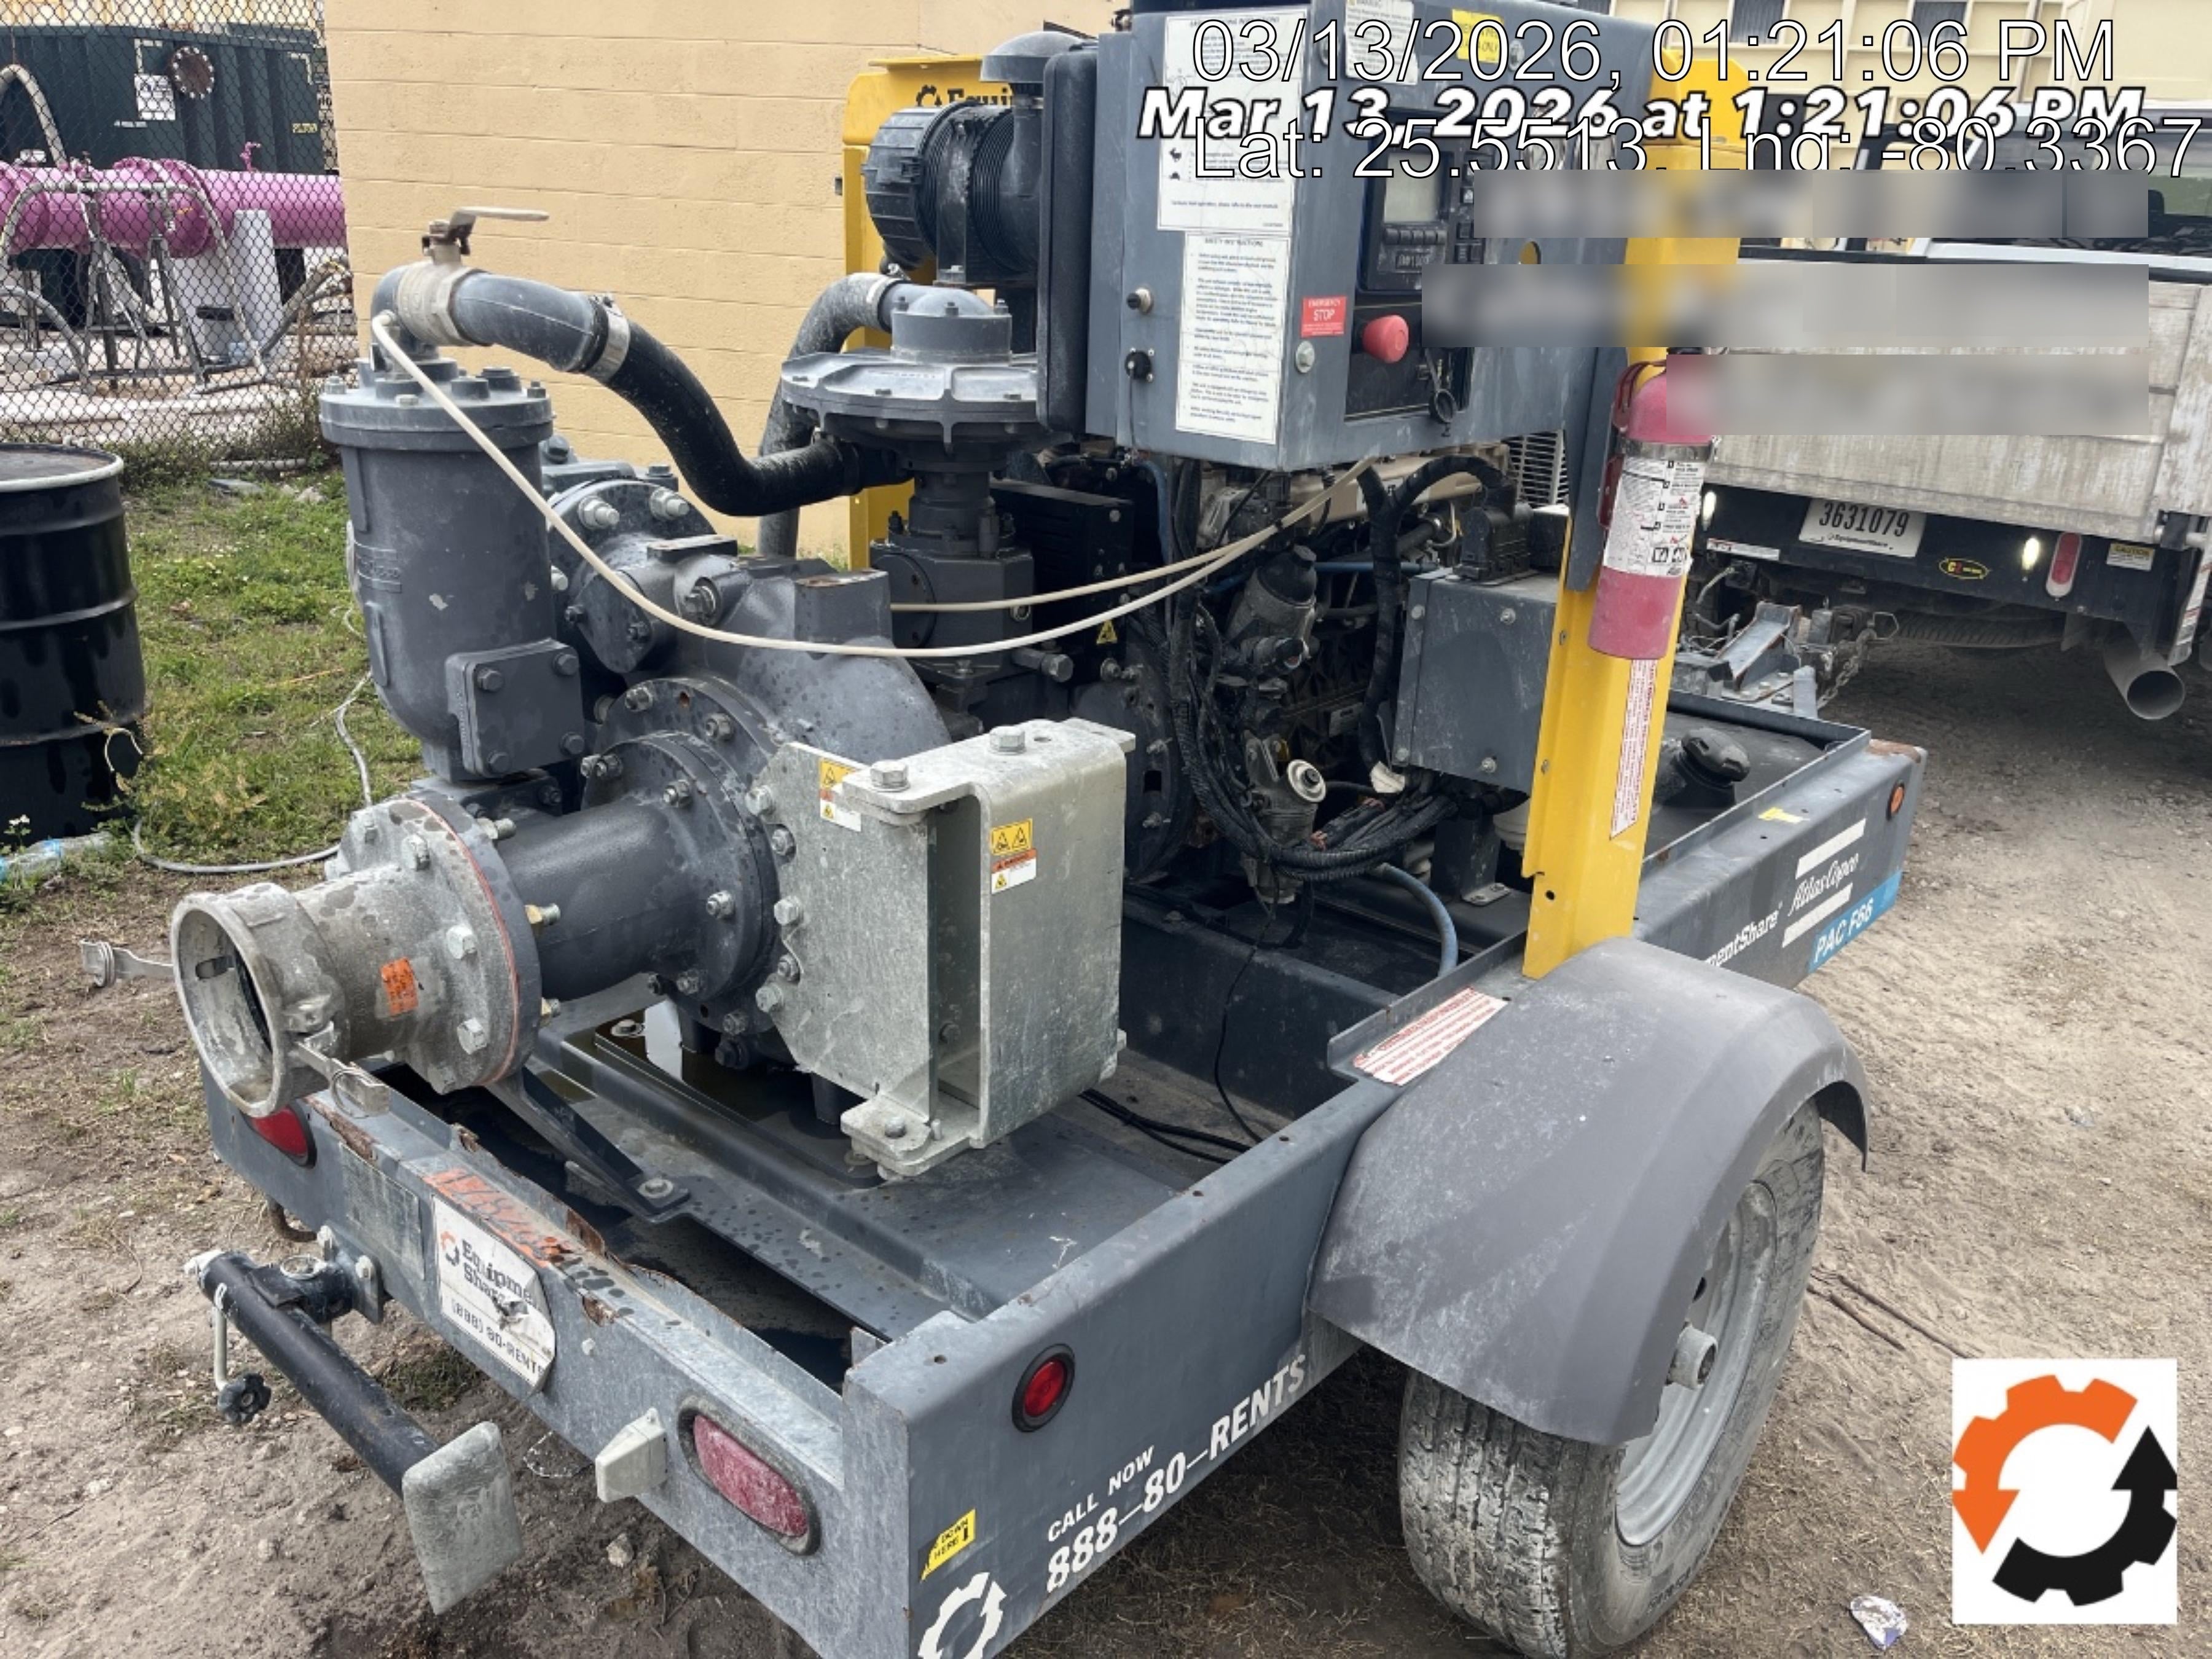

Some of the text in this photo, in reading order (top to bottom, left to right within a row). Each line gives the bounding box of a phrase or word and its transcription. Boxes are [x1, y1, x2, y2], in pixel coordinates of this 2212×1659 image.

[1314, 308, 1335, 321] STOP
[1819, 501, 1910, 537] 3631079
[1813, 897, 1874, 963] PAC F66
[1048, 1445, 1155, 1542] CALL NOW
[941, 1518, 969, 1543] DOWN
[933, 1535, 959, 1559] HERE
